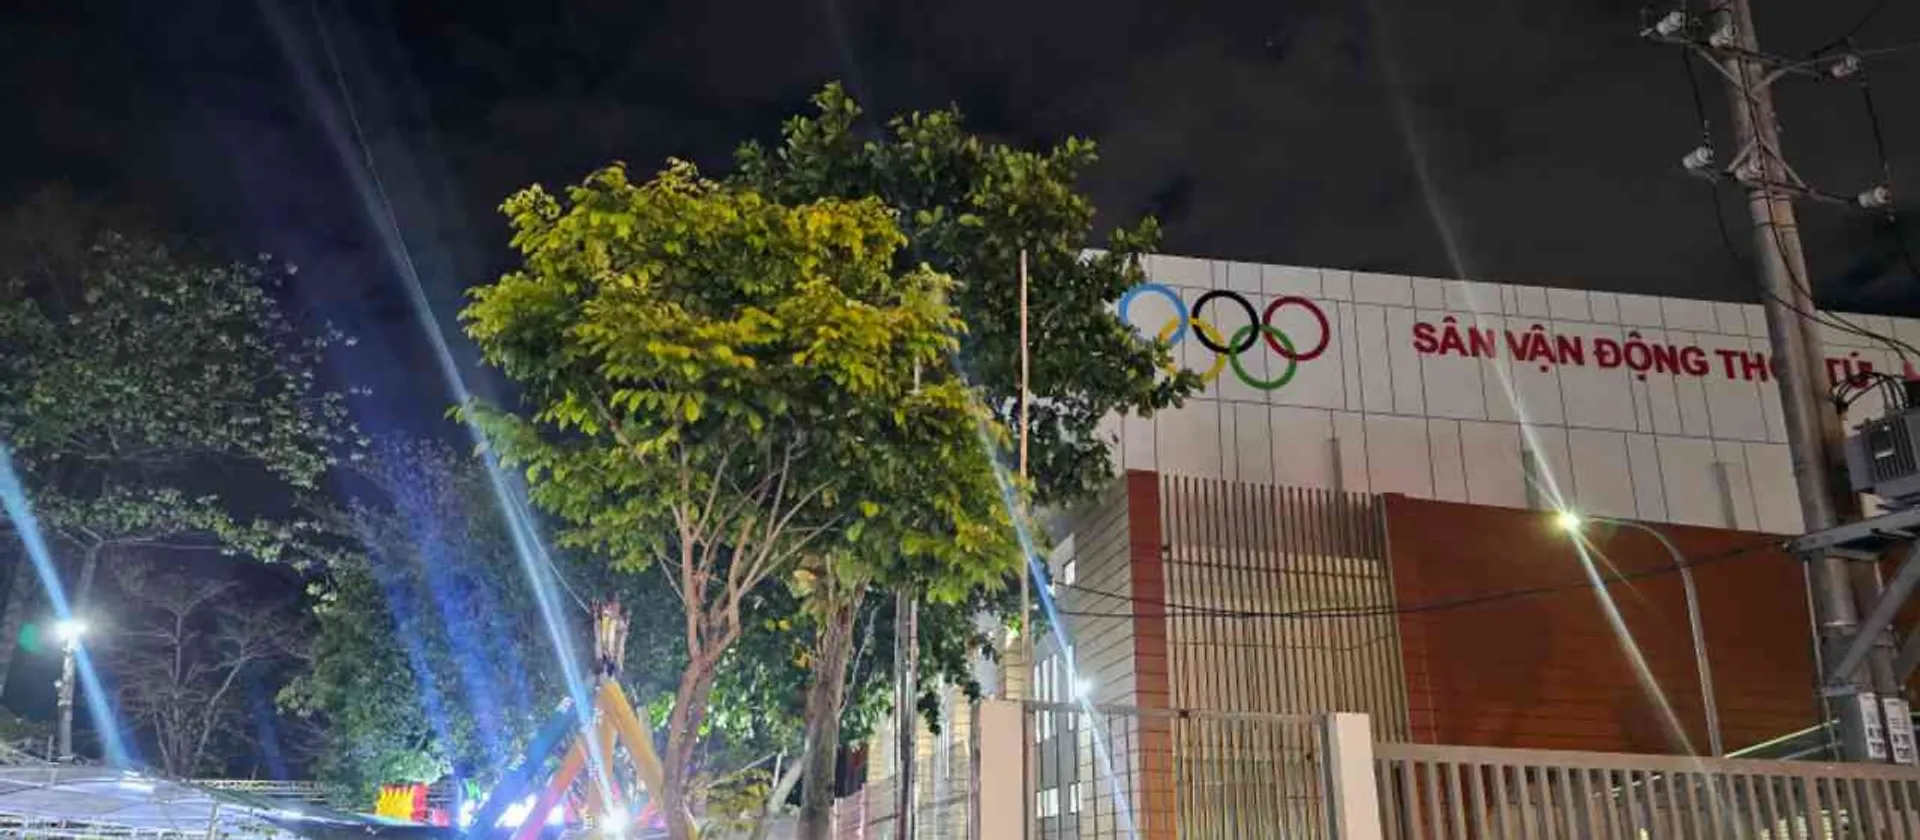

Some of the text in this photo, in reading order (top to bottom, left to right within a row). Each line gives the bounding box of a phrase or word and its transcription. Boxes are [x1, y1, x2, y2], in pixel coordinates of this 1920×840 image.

[1413, 316, 1496, 358] SÂN
[1504, 324, 1585, 373] VẬN
[1593, 330, 1710, 381] ĐỘNG
[1714, 349, 1778, 382] TH
